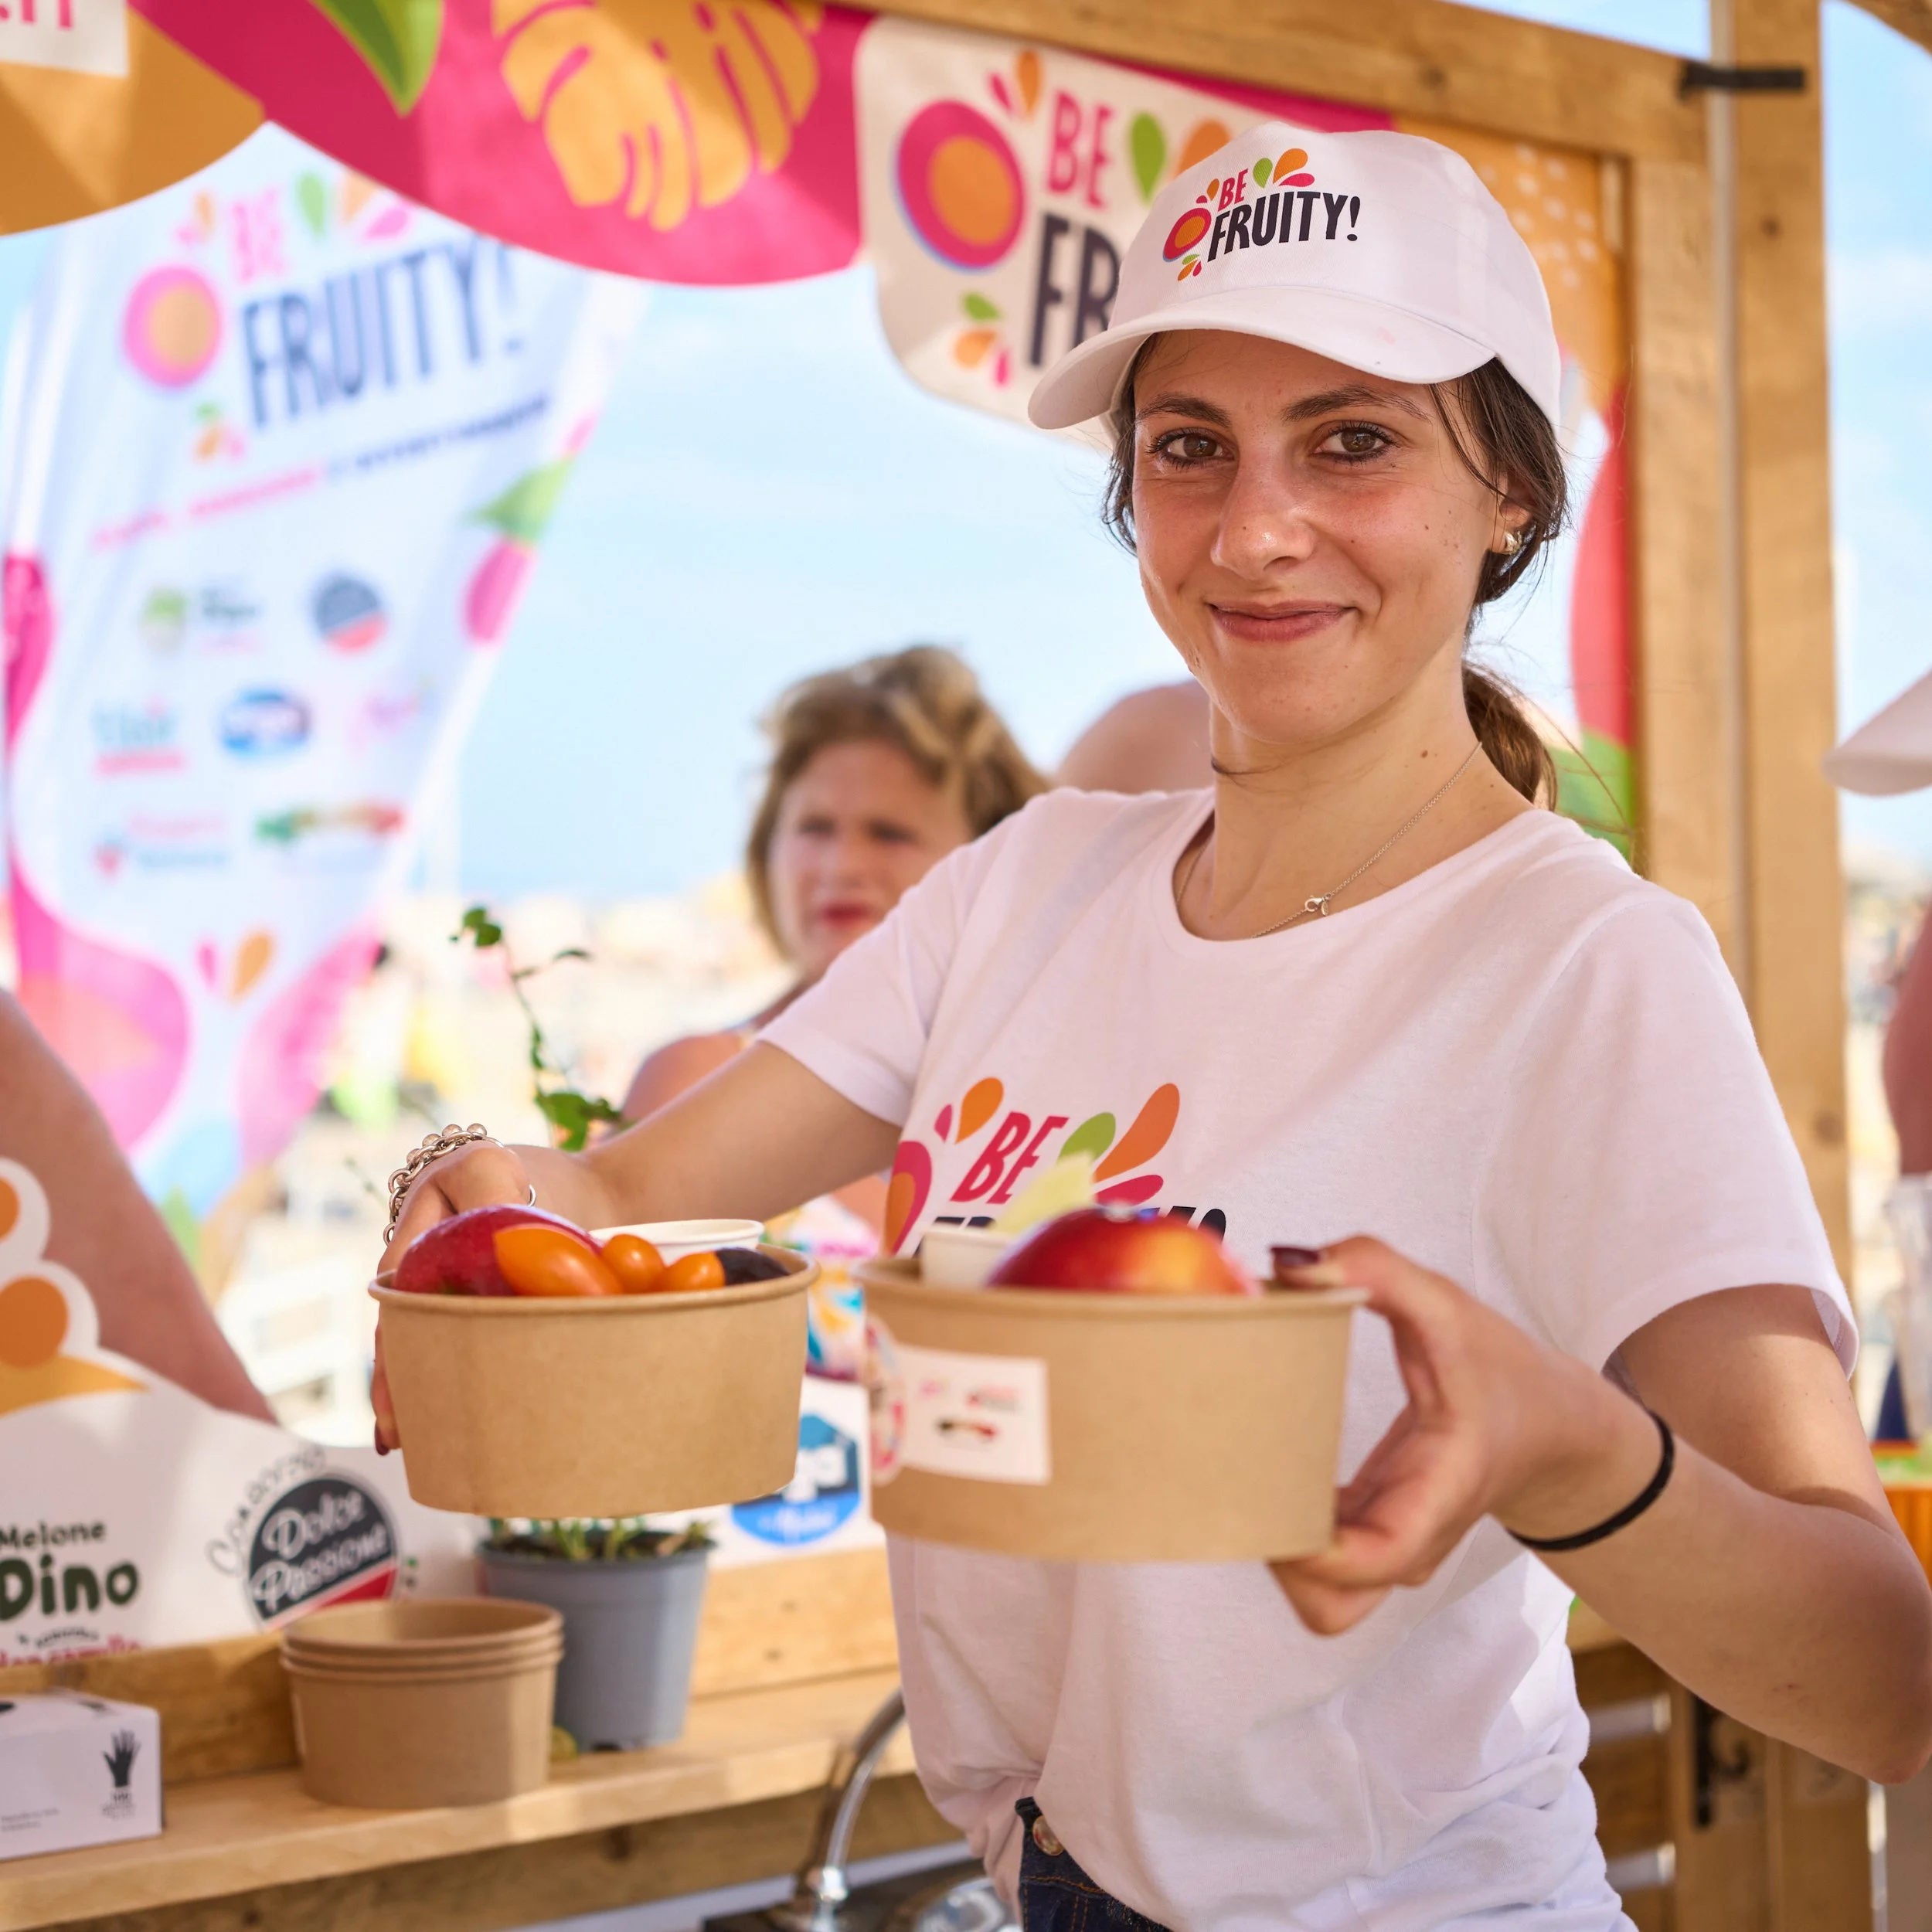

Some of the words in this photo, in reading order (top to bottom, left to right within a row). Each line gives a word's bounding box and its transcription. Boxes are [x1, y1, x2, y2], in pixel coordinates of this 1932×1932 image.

[1048, 90, 1115, 211] BE
[1206, 190, 1361, 263] FRUITY!
[1217, 168, 1249, 212] BE
[243, 232, 524, 430] FRUITY!
[949, 1111, 1070, 1204] BE
[260, 1489, 366, 1561] Dolce
[0, 1553, 140, 1621] Dino
